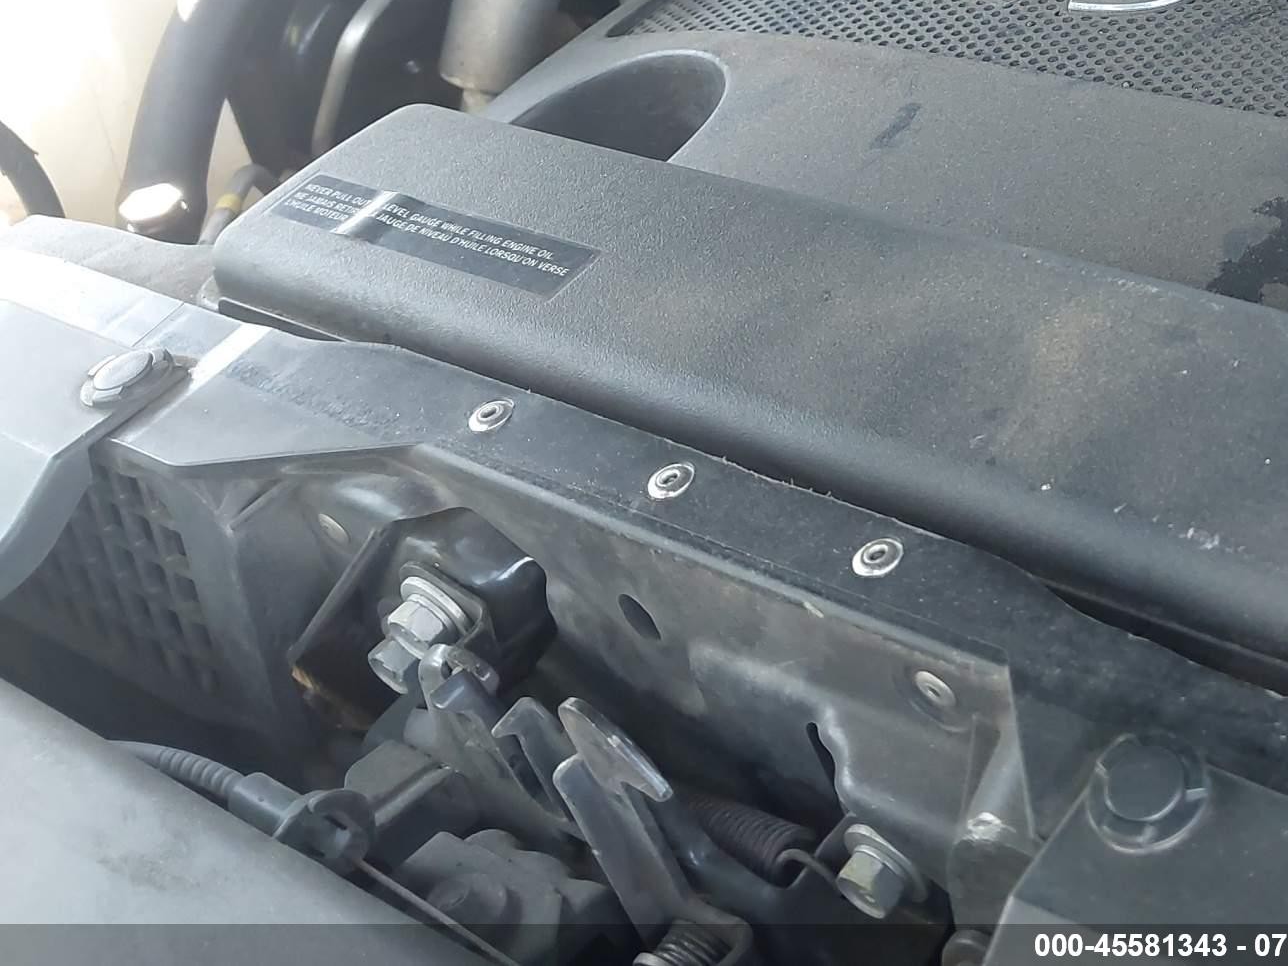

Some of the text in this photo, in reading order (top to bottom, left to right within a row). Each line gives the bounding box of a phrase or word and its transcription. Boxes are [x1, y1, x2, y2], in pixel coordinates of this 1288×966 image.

[305, 184, 554, 260] NEVER PULL OUT LEVEL GAUGE WHILE FILLING ENGINE OIL
[309, 195, 336, 207] JAMAIS
[376, 213, 408, 229] JAUGE
[405, 223, 421, 233] DE
[418, 227, 453, 242] NIVEAU
[449, 236, 488, 252] D'HUILE
[537, 261, 570, 276] VERSE
